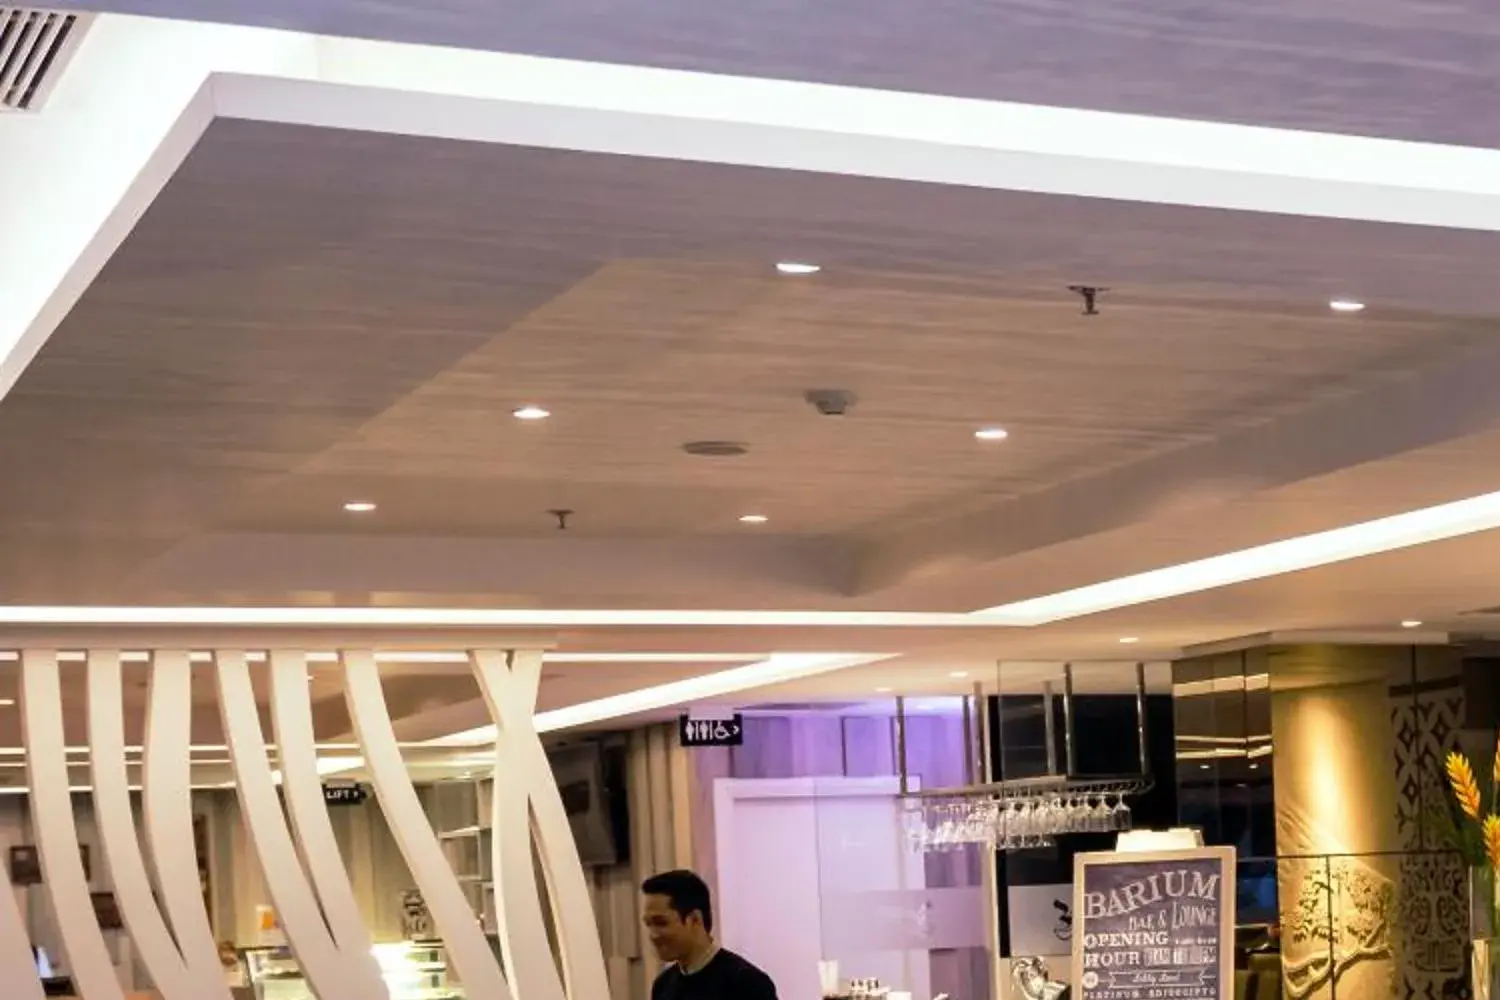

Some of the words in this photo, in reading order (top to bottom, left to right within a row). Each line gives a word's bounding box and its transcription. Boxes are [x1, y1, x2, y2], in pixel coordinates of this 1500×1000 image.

[326, 790, 349, 799] LIFT
[1082, 869, 1219, 919] BARIUM
[1085, 931, 1169, 949] OPENING
[1085, 951, 1140, 969] HOUR
